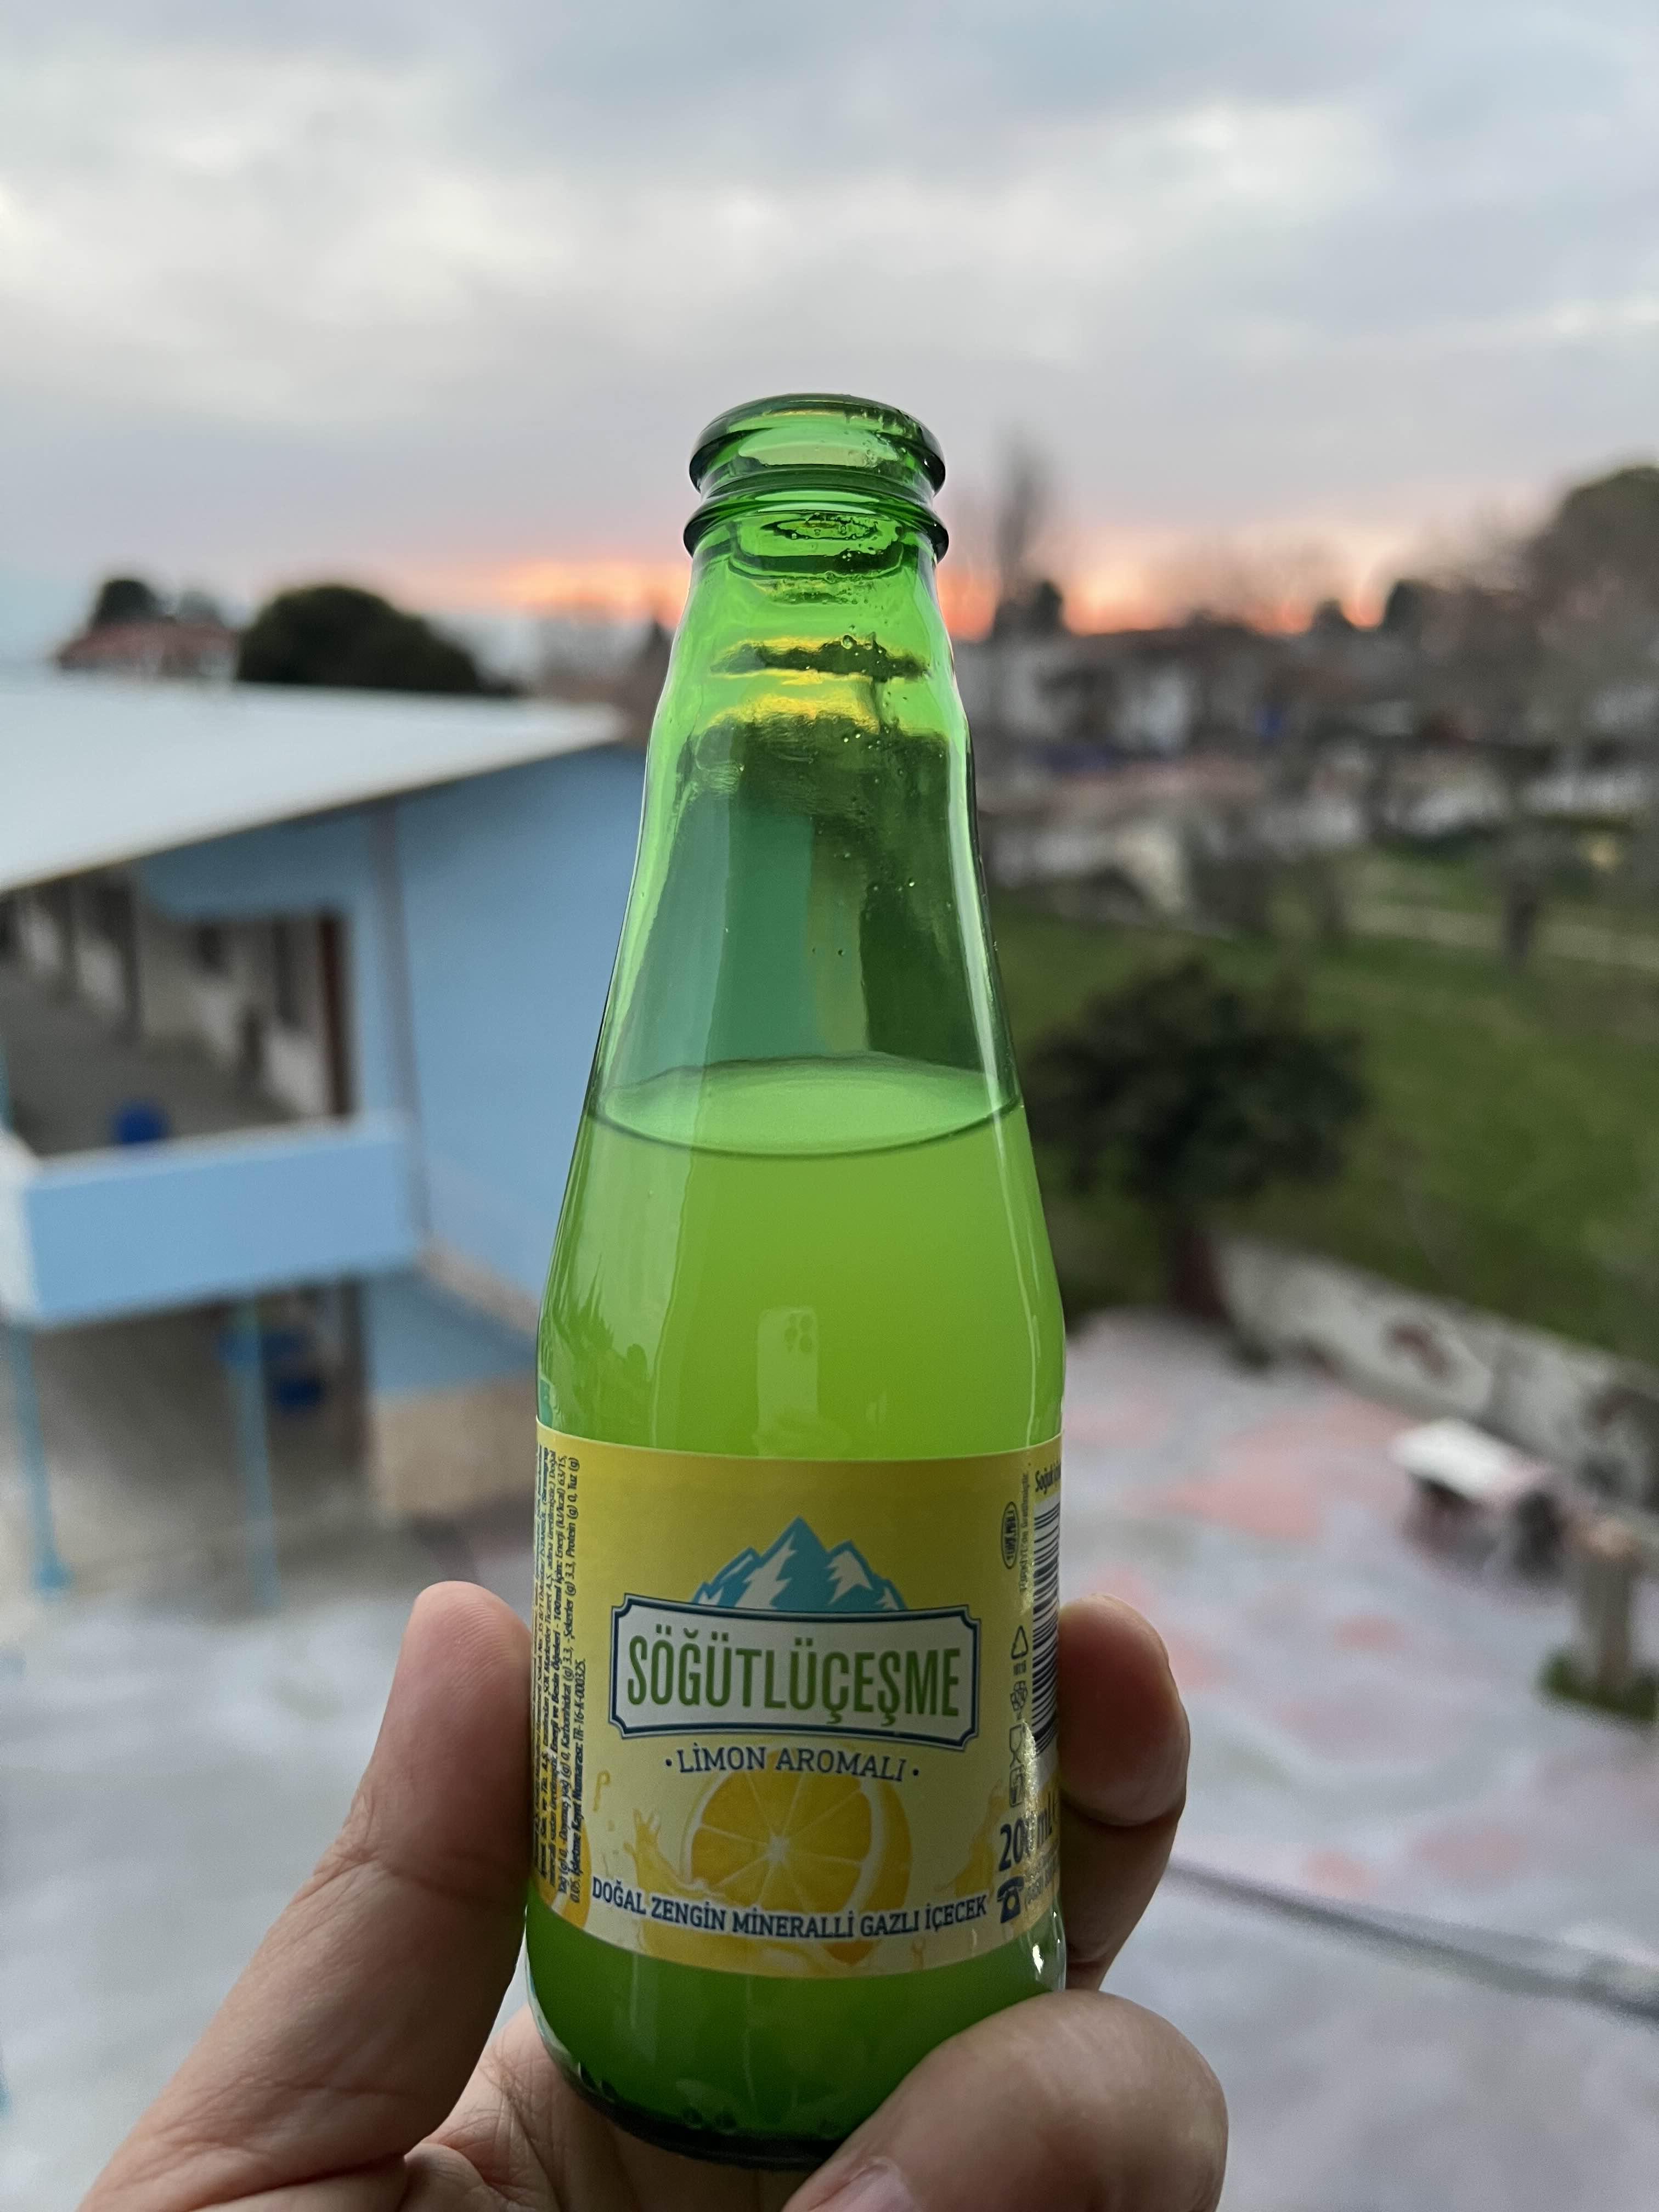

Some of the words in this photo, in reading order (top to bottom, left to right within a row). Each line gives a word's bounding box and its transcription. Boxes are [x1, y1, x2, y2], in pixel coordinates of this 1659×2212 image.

[628, 1624, 960, 1726] SÖĞÜTLÜÇEŞME
[677, 1742, 766, 1773] LİMON
[775, 1748, 906, 1781] AROMALI
[592, 1876, 646, 1915] DOĞAL
[651, 1901, 726, 1931] ZENGİN
[732, 1908, 854, 1938] MİNERALLİ
[860, 1910, 920, 1937] GAZLI
[924, 1894, 986, 1932] İÇECEK
